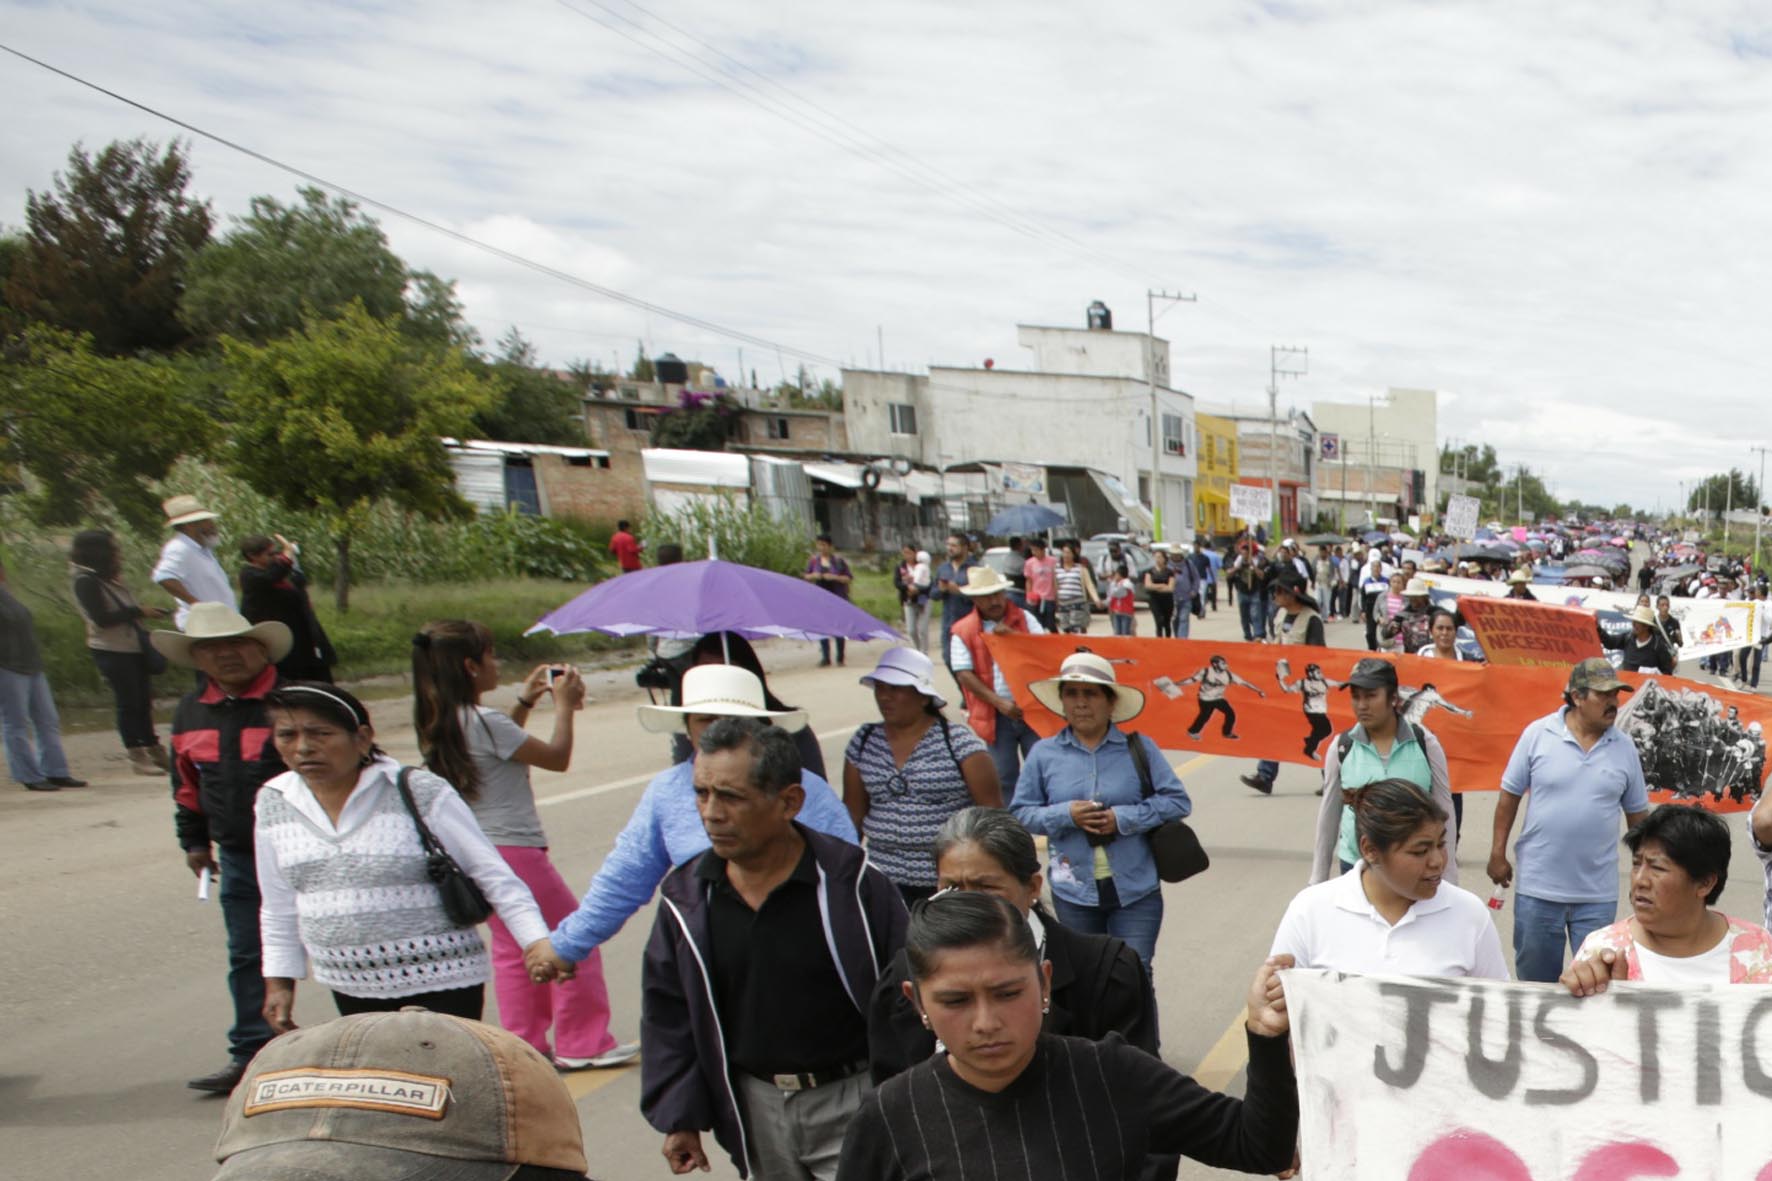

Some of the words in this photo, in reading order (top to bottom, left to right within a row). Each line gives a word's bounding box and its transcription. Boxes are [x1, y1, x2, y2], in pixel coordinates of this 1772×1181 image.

[1478, 617, 1594, 644] HUMANIDAD
[1486, 634, 1576, 655] NECESITA
[278, 1081, 425, 1100] CATERPILLAR
